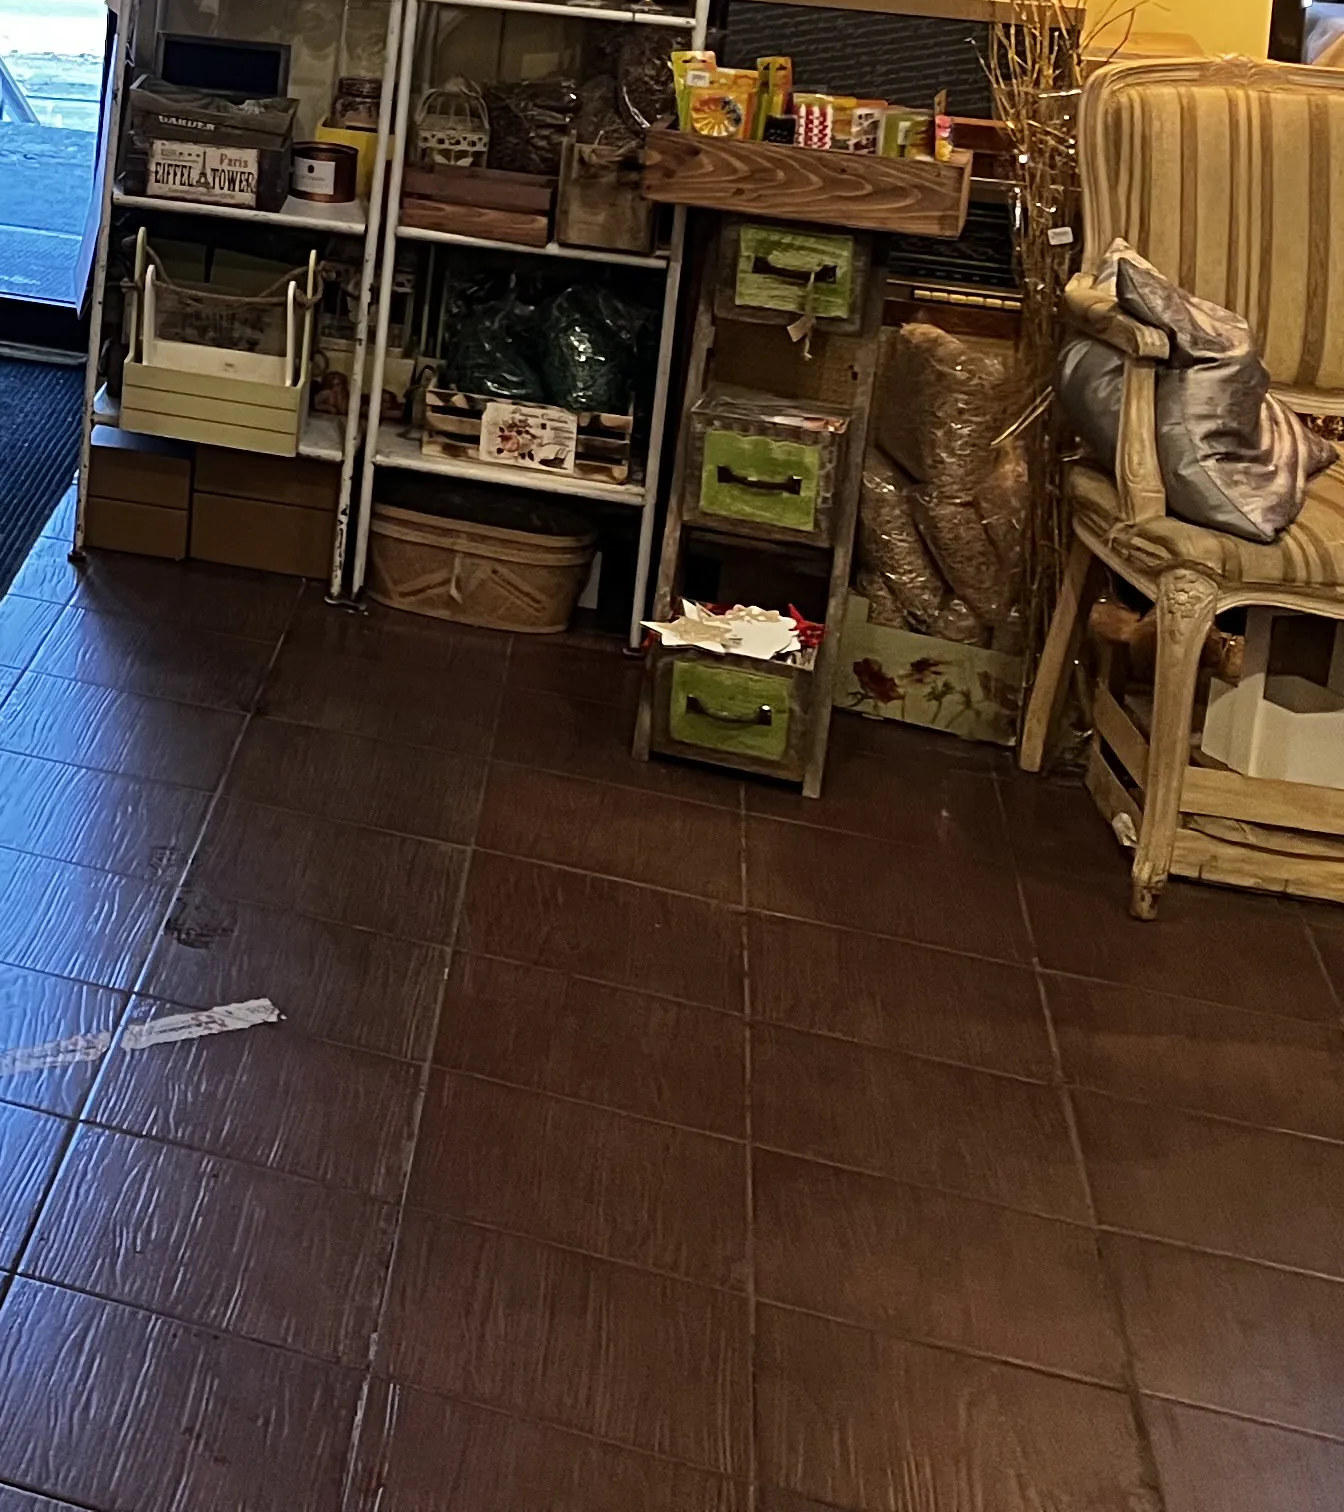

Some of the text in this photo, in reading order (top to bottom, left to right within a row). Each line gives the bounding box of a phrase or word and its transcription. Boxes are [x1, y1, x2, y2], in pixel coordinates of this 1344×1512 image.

[218, 152, 250, 169] Paris
[154, 162, 194, 187] EIFFEL
[210, 166, 257, 194] TOWER
